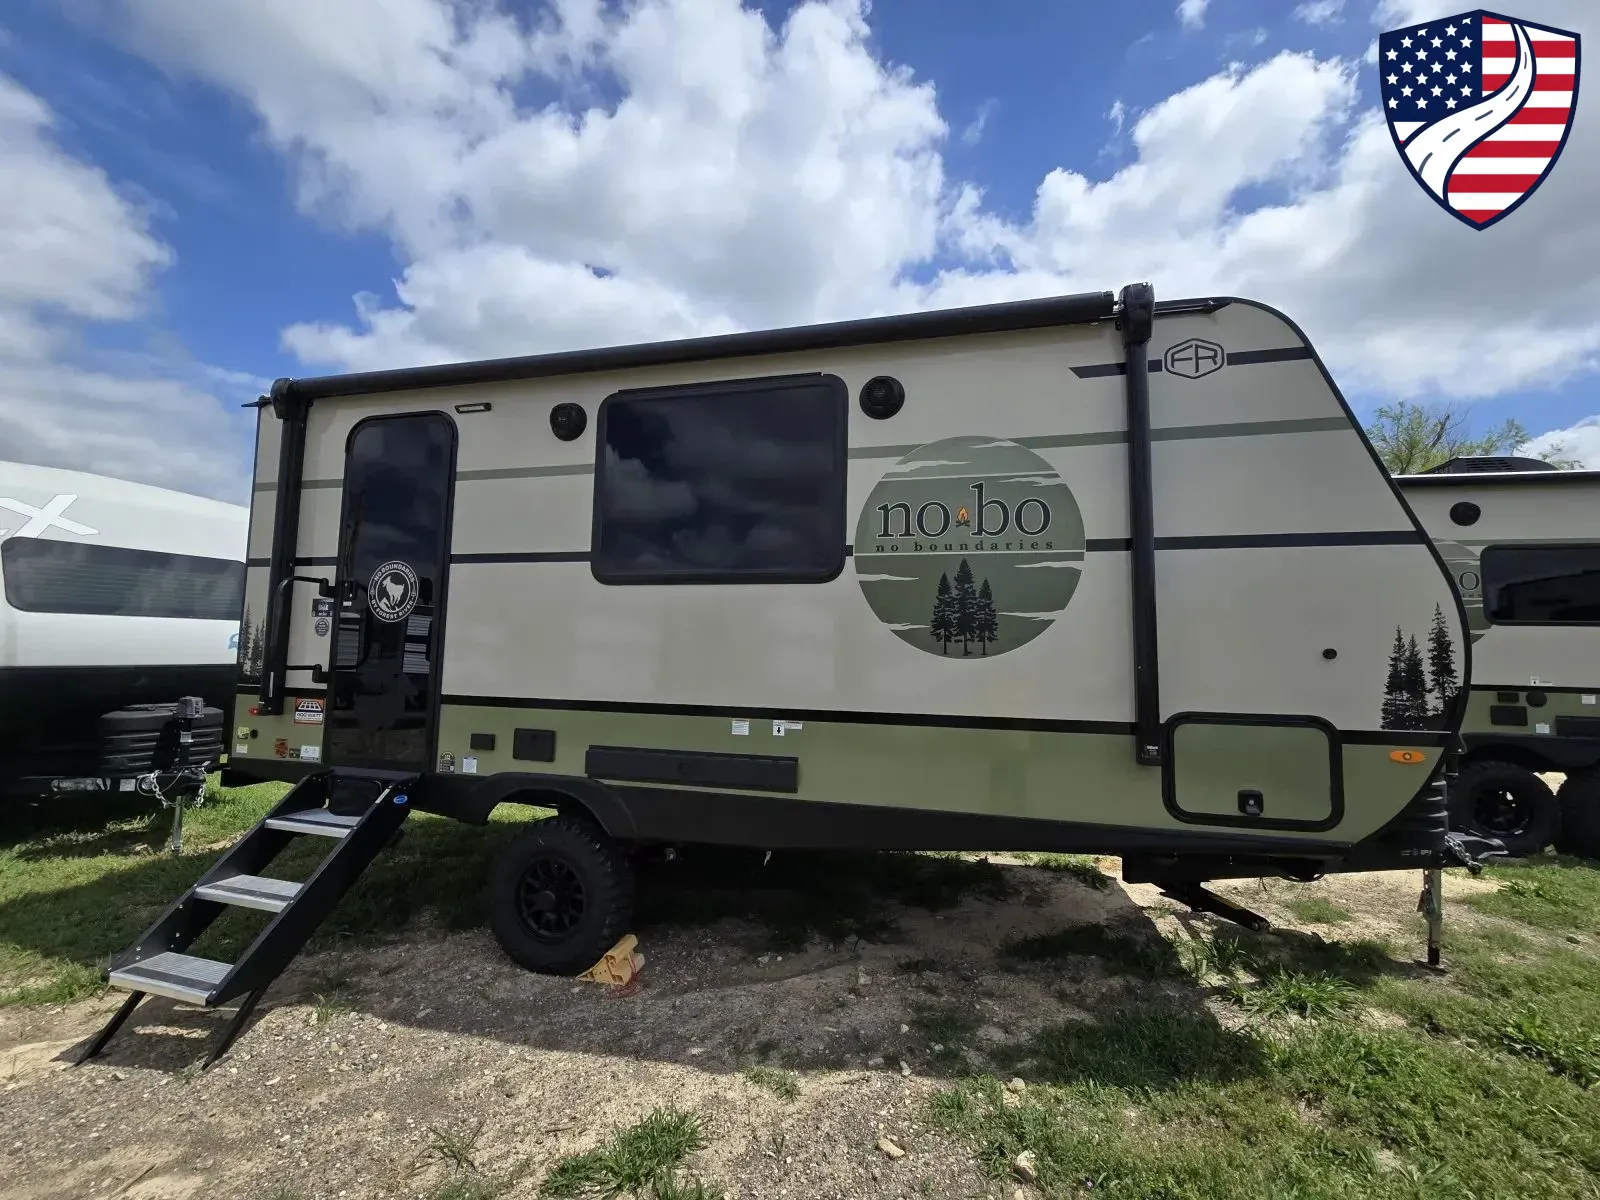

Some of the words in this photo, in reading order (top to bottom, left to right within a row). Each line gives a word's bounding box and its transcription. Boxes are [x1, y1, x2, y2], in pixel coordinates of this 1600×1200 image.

[875, 544, 899, 552] no
[914, 540, 1054, 551] boundaries
[381, 563, 415, 582] BOUNDARIES
[376, 608, 398, 619] FOREST
[398, 600, 413, 617] RIVER
